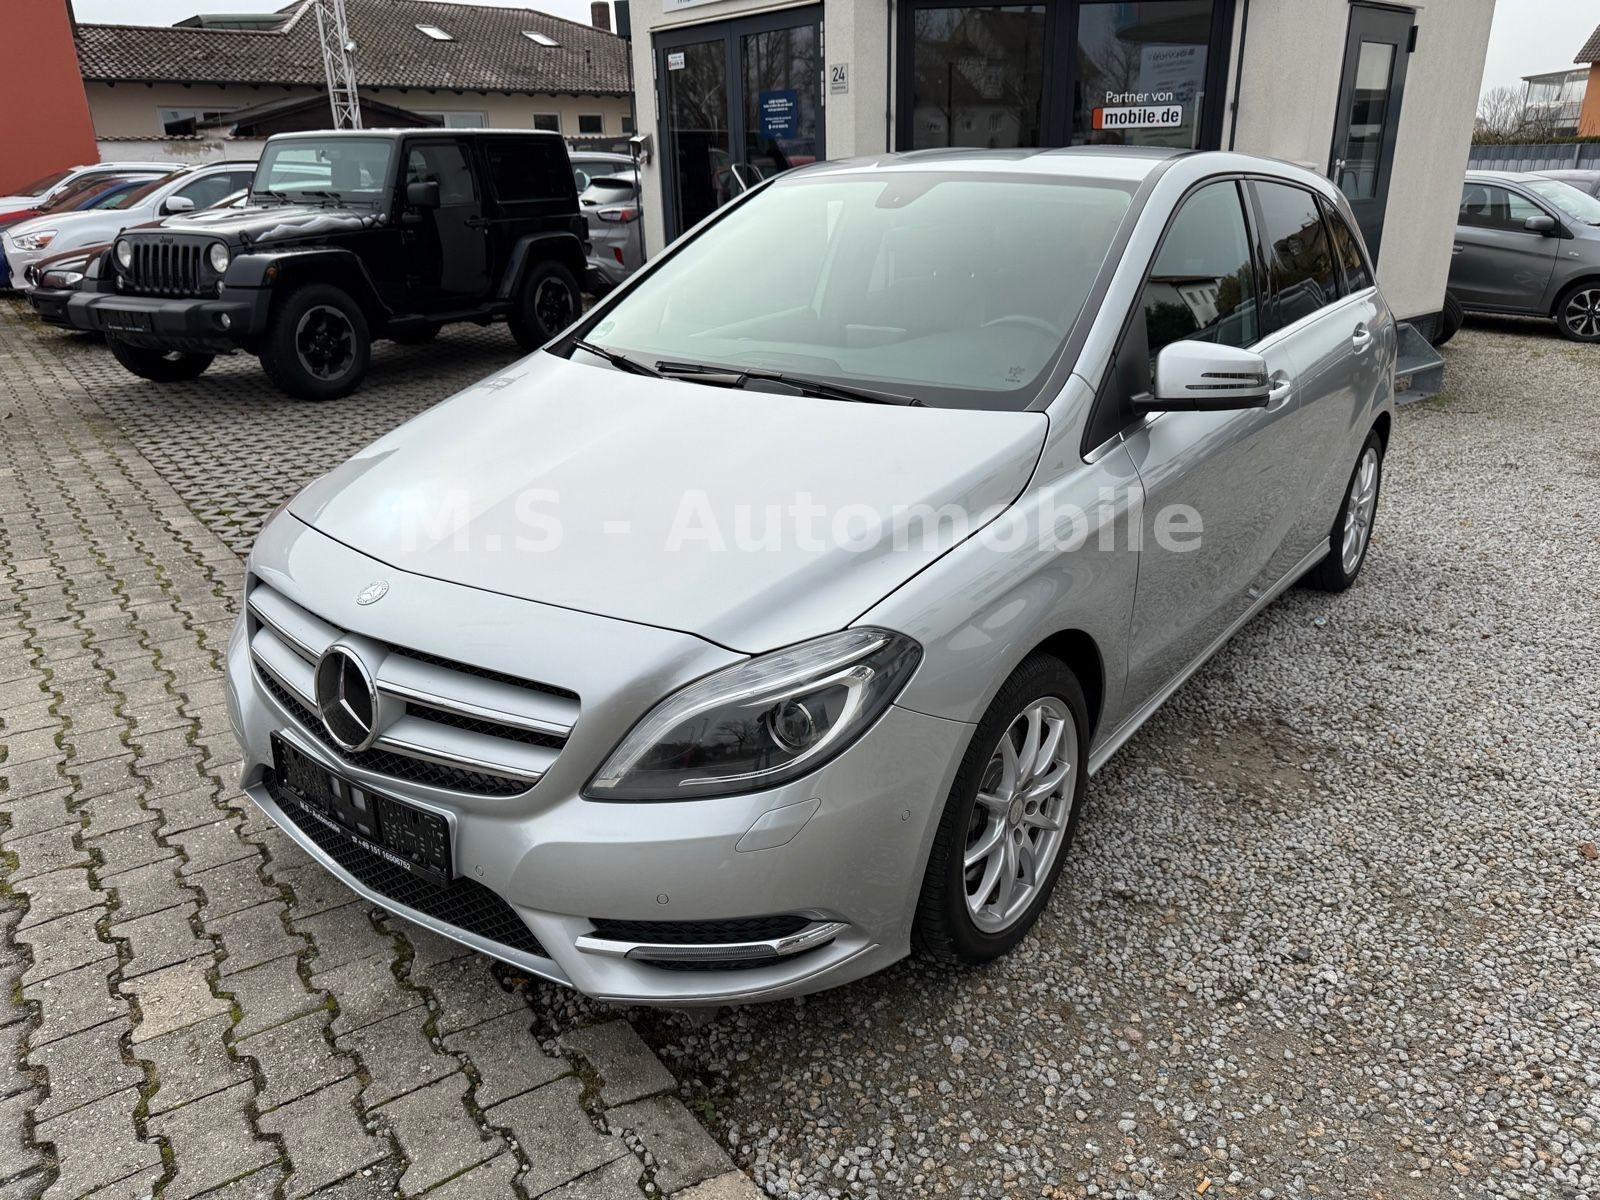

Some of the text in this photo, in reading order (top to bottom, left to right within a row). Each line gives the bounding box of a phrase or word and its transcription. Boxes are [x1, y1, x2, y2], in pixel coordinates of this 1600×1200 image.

[832, 66, 845, 82] 24
[1105, 91, 1173, 103] Partner von
[1105, 108, 1179, 125] mobile.de
